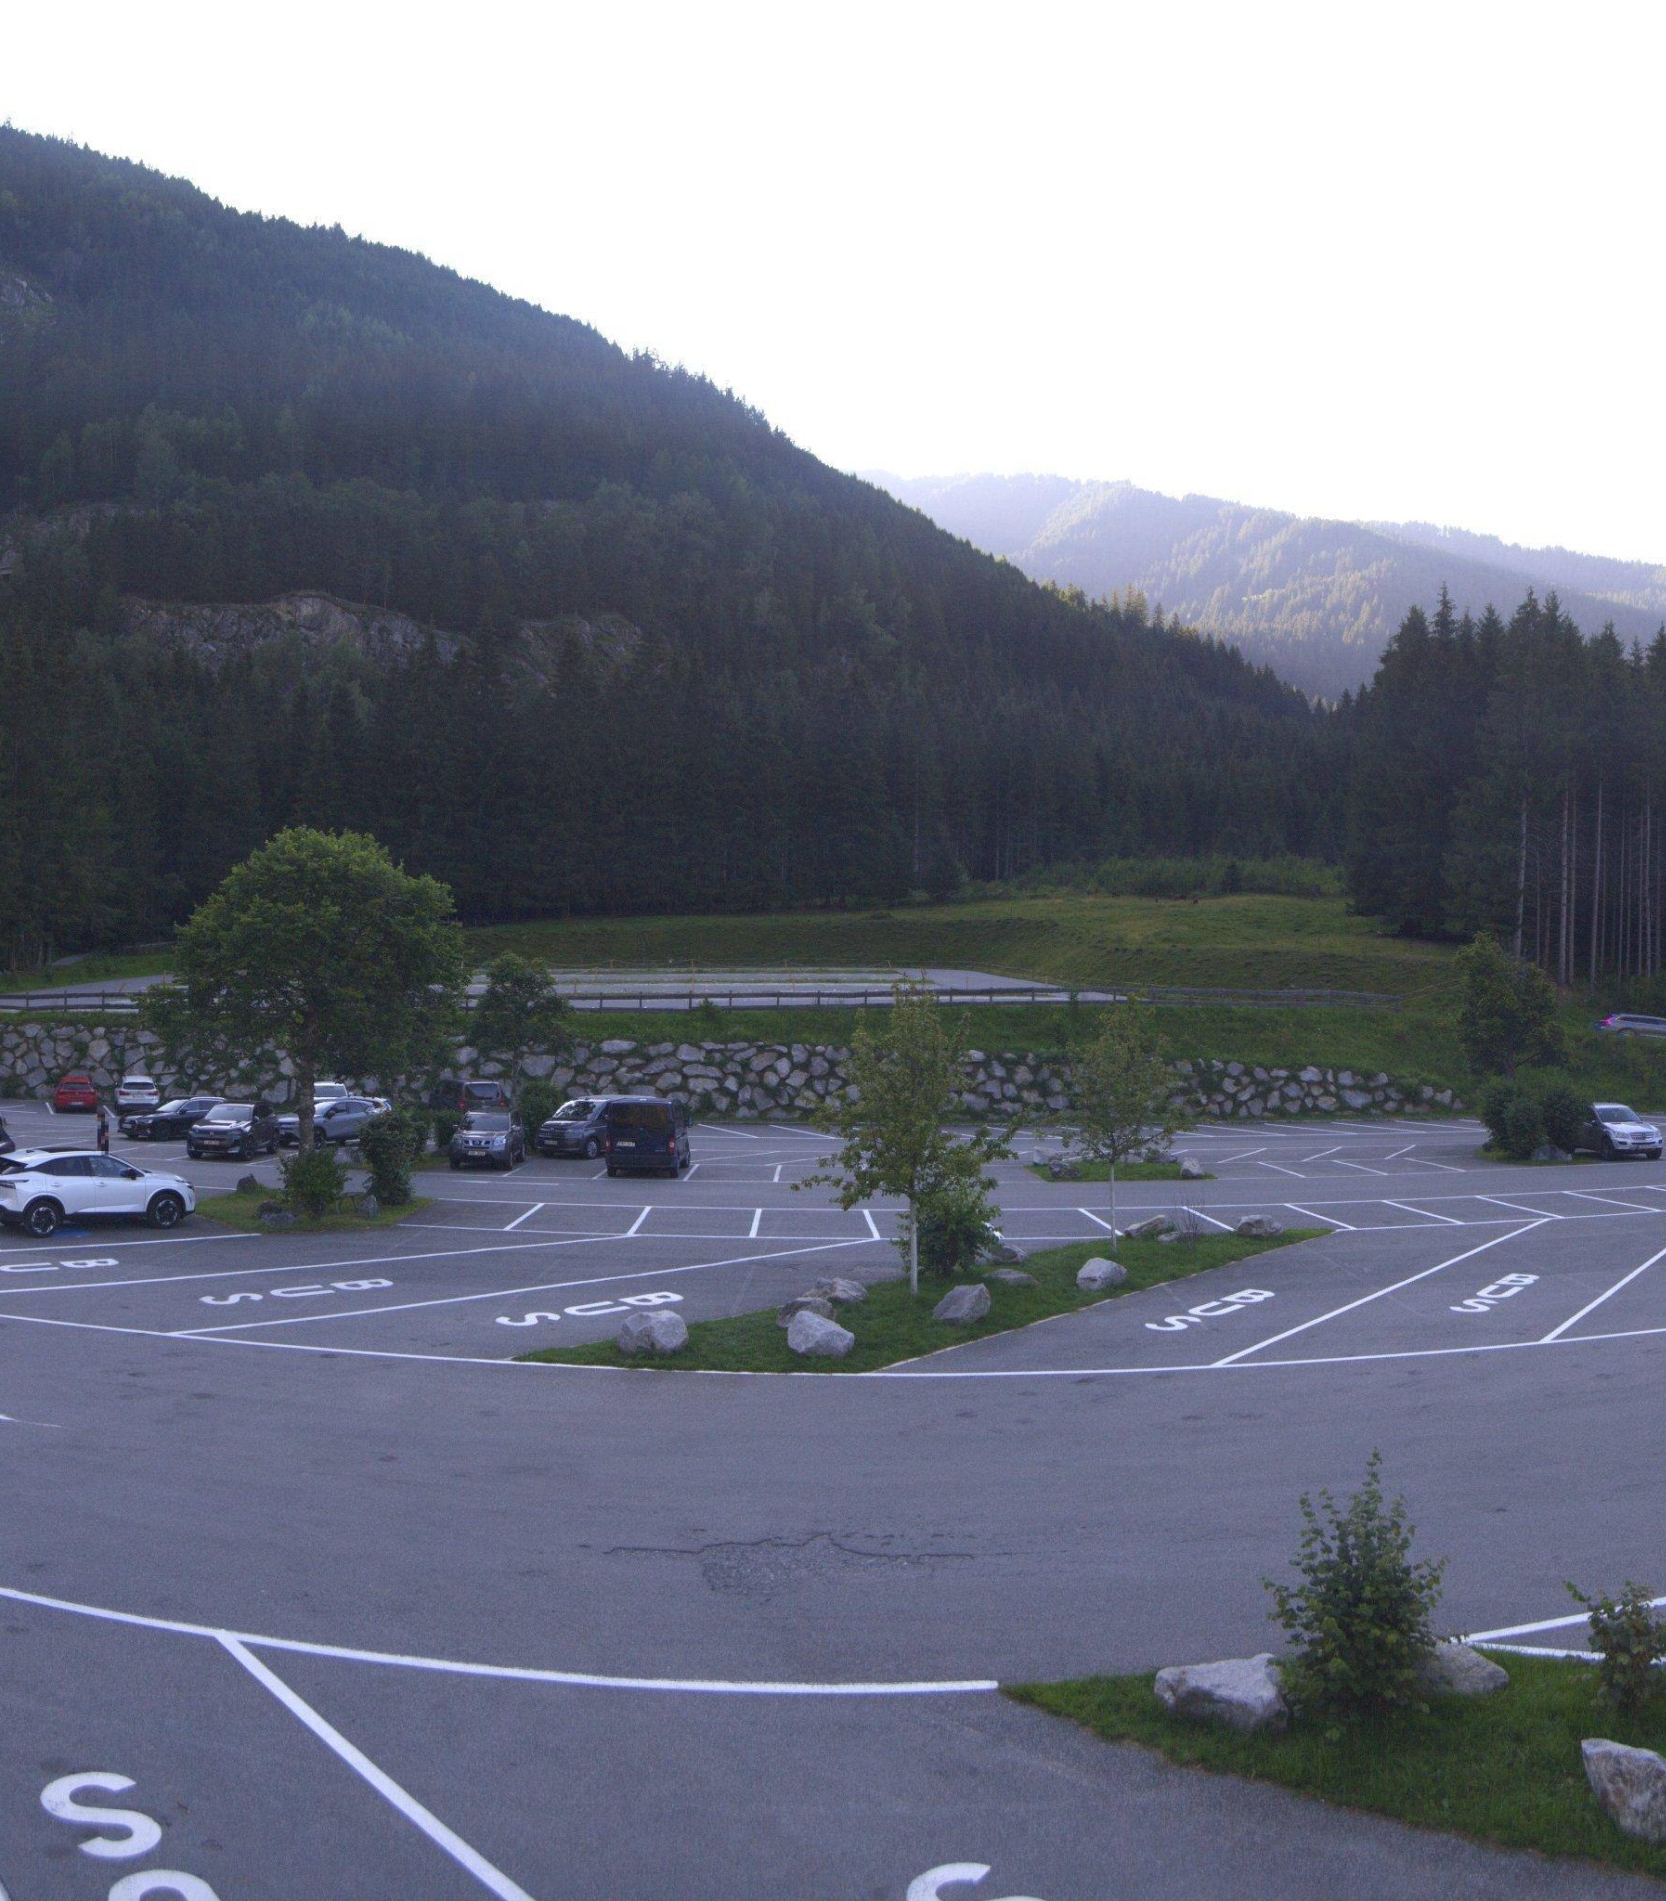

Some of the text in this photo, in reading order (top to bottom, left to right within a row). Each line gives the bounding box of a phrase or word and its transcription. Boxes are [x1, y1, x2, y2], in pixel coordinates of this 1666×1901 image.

[199, 1277, 395, 1306] BUS
[494, 1290, 685, 1328] BUS
[1144, 1287, 1276, 1331] BUS
[1449, 1272, 1540, 1313] BUS
